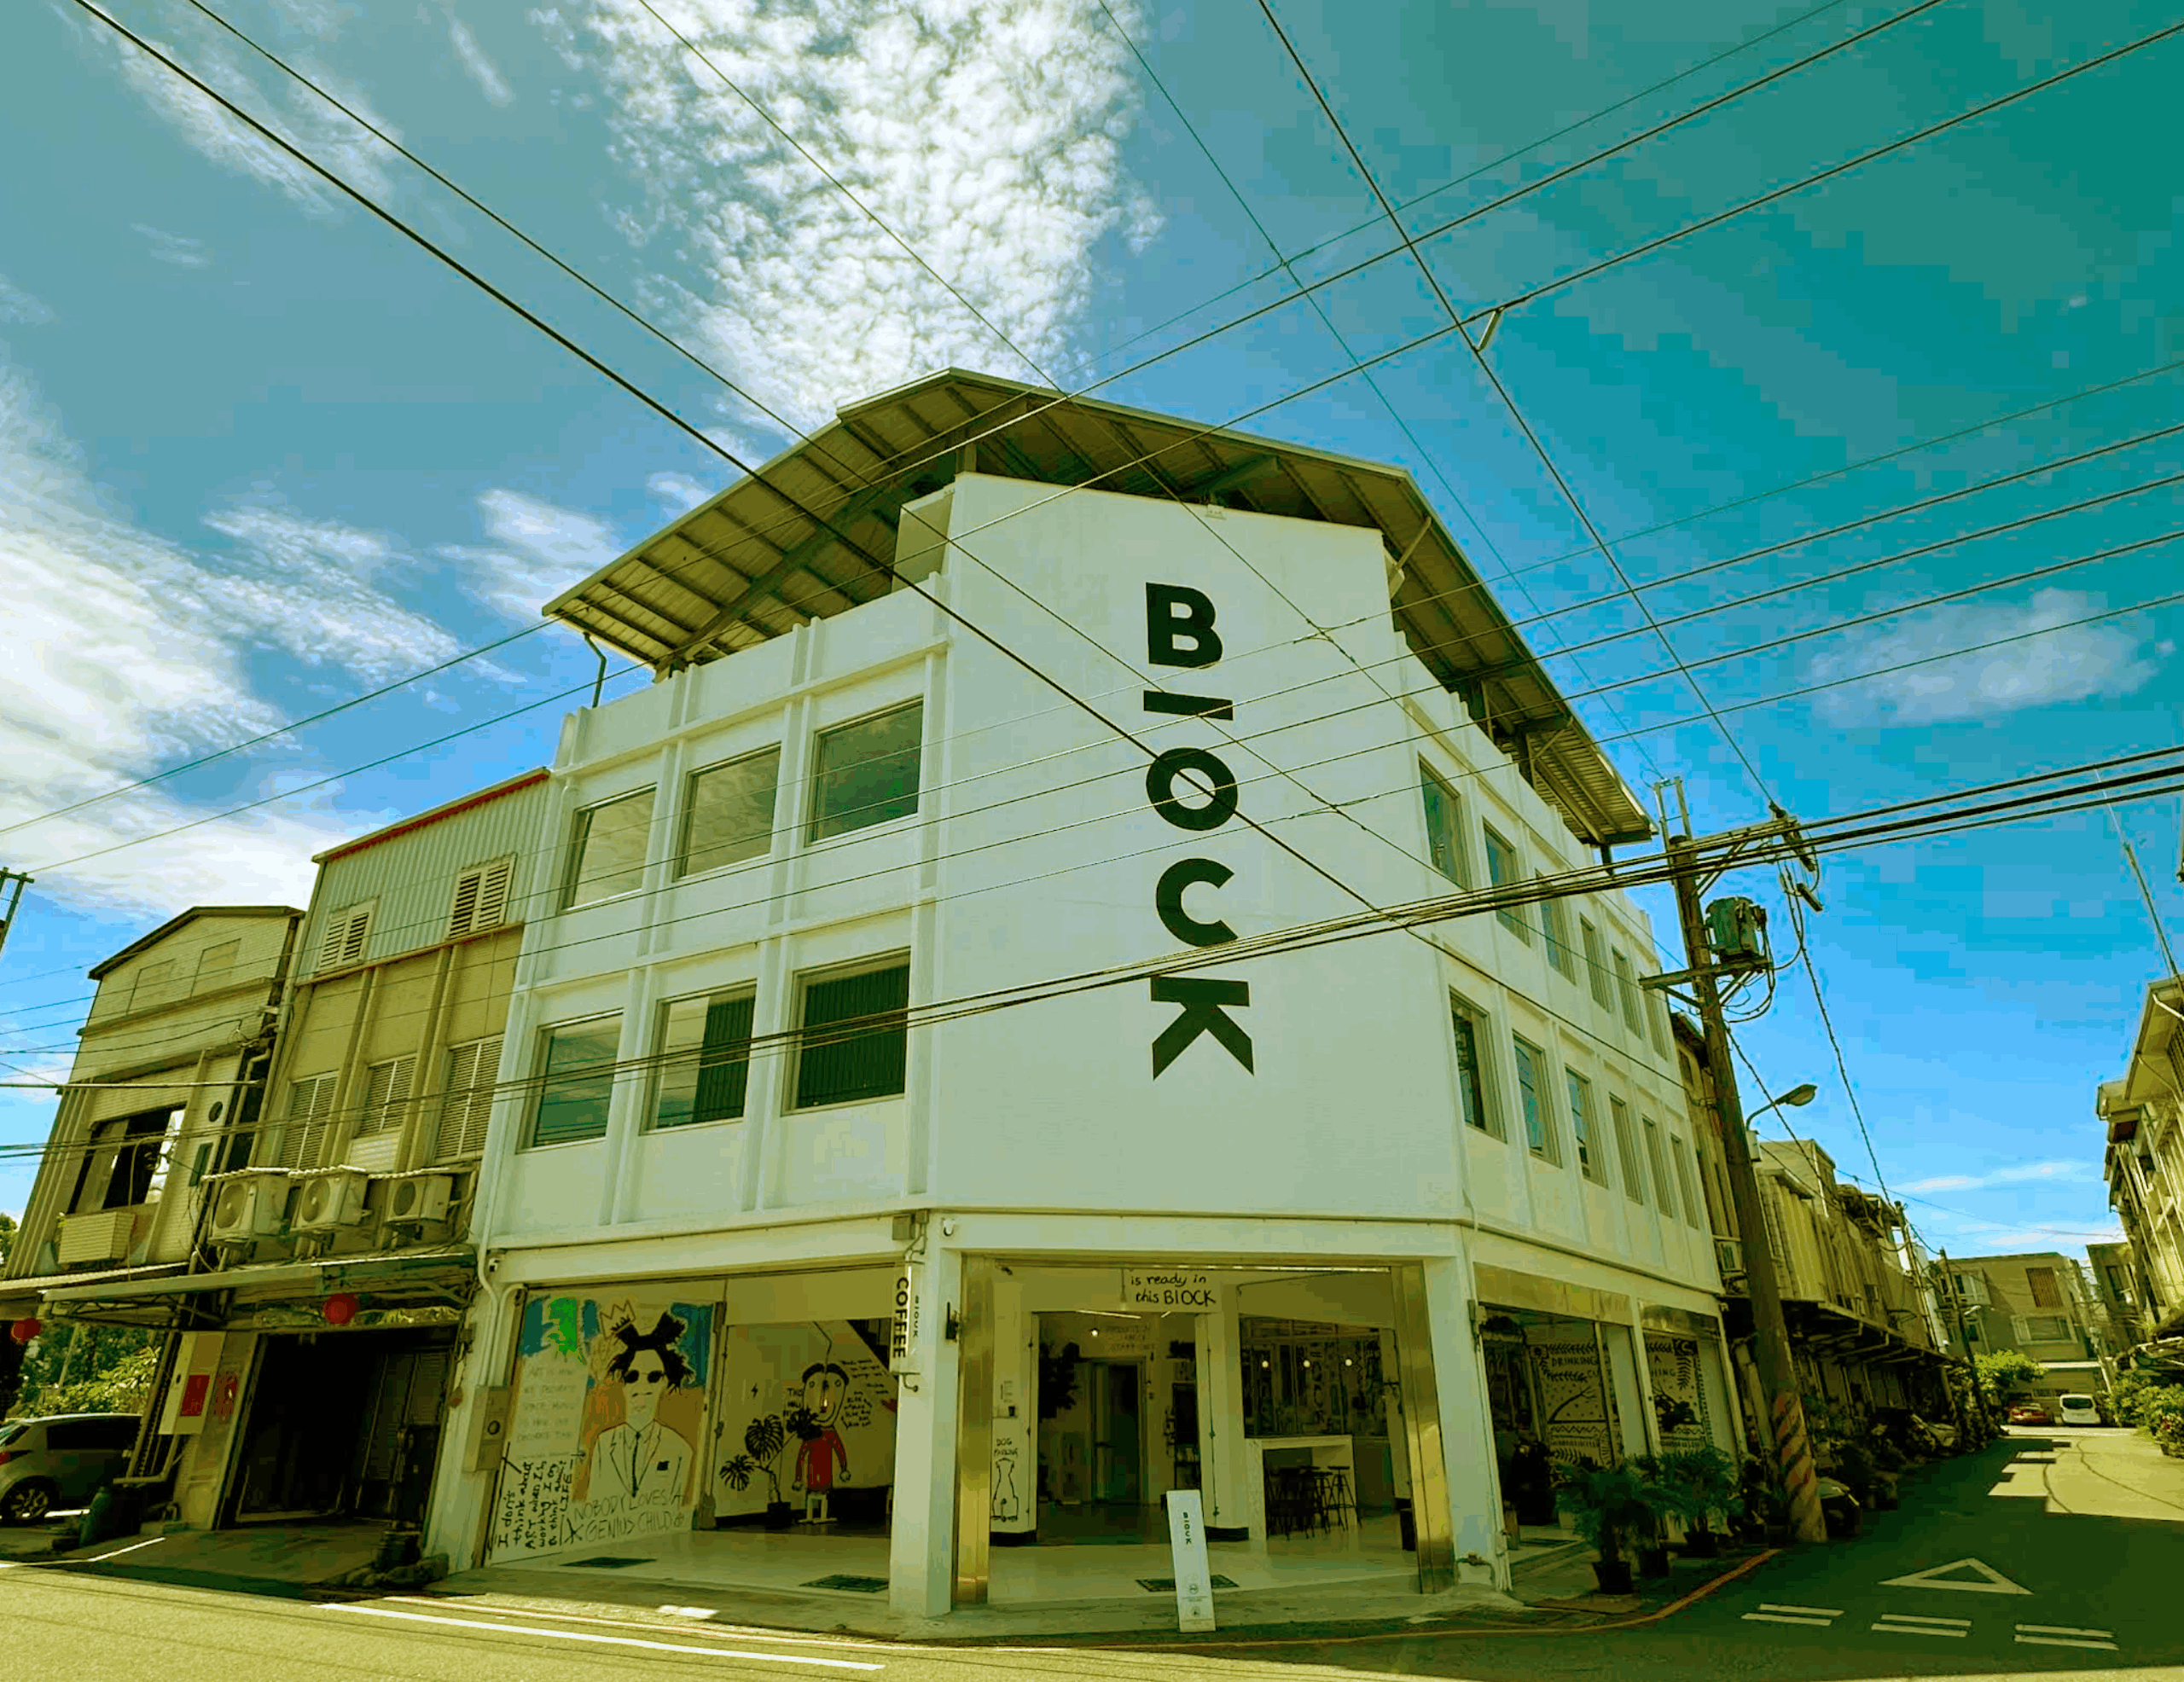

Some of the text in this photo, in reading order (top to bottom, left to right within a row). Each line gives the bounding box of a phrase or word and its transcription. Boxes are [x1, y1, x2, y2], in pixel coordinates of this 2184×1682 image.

[1130, 1273, 1206, 1287] is ready in
[1136, 1289, 1159, 1303] this
[893, 1276, 909, 1358] COFFEE
[996, 1437, 1013, 1447] DOG
[574, 1493, 626, 1522] NOBODY
[629, 1488, 668, 1511] LOVES
[513, 1499, 526, 1546] think
[524, 1519, 537, 1550] ART
[585, 1511, 672, 1542] GENIUS CHILD
